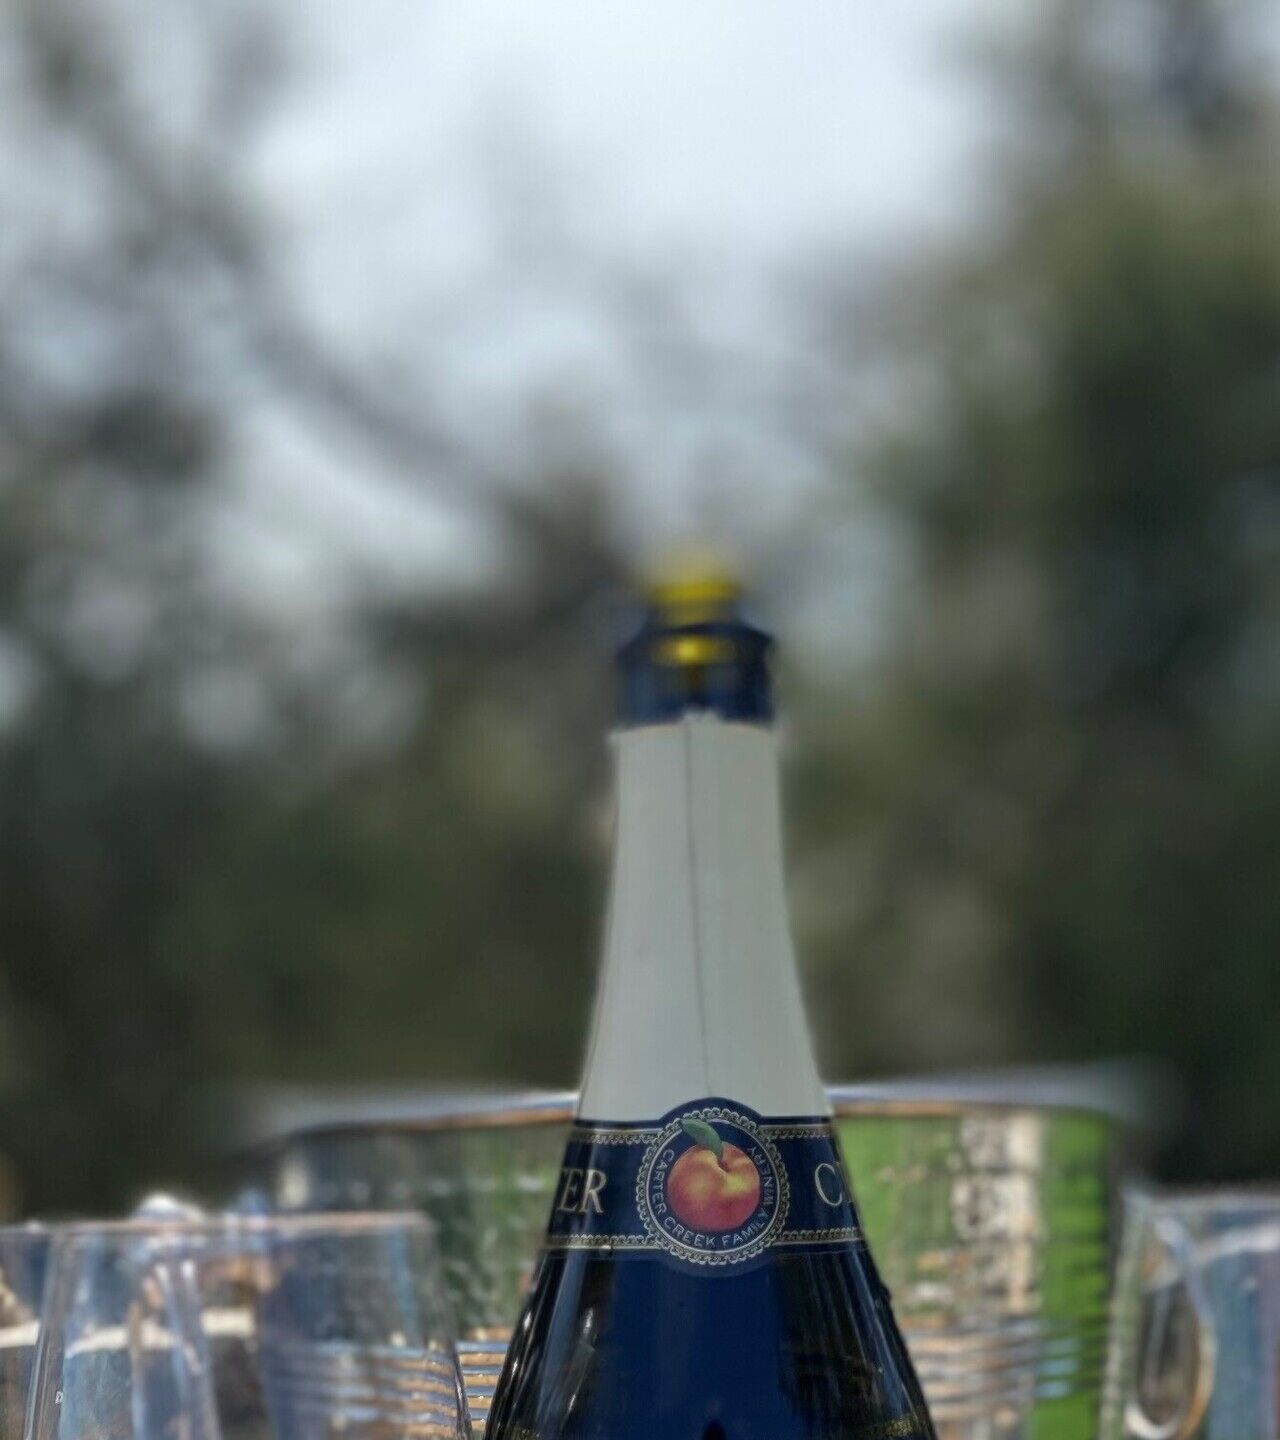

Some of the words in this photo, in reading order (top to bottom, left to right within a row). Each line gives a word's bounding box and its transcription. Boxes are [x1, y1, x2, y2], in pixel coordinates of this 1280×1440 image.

[651, 1148, 676, 1214] CARTER
[664, 1216, 716, 1248] CREEK
[720, 1206, 769, 1246] FAMILY
[749, 1146, 775, 1206] WINERY
